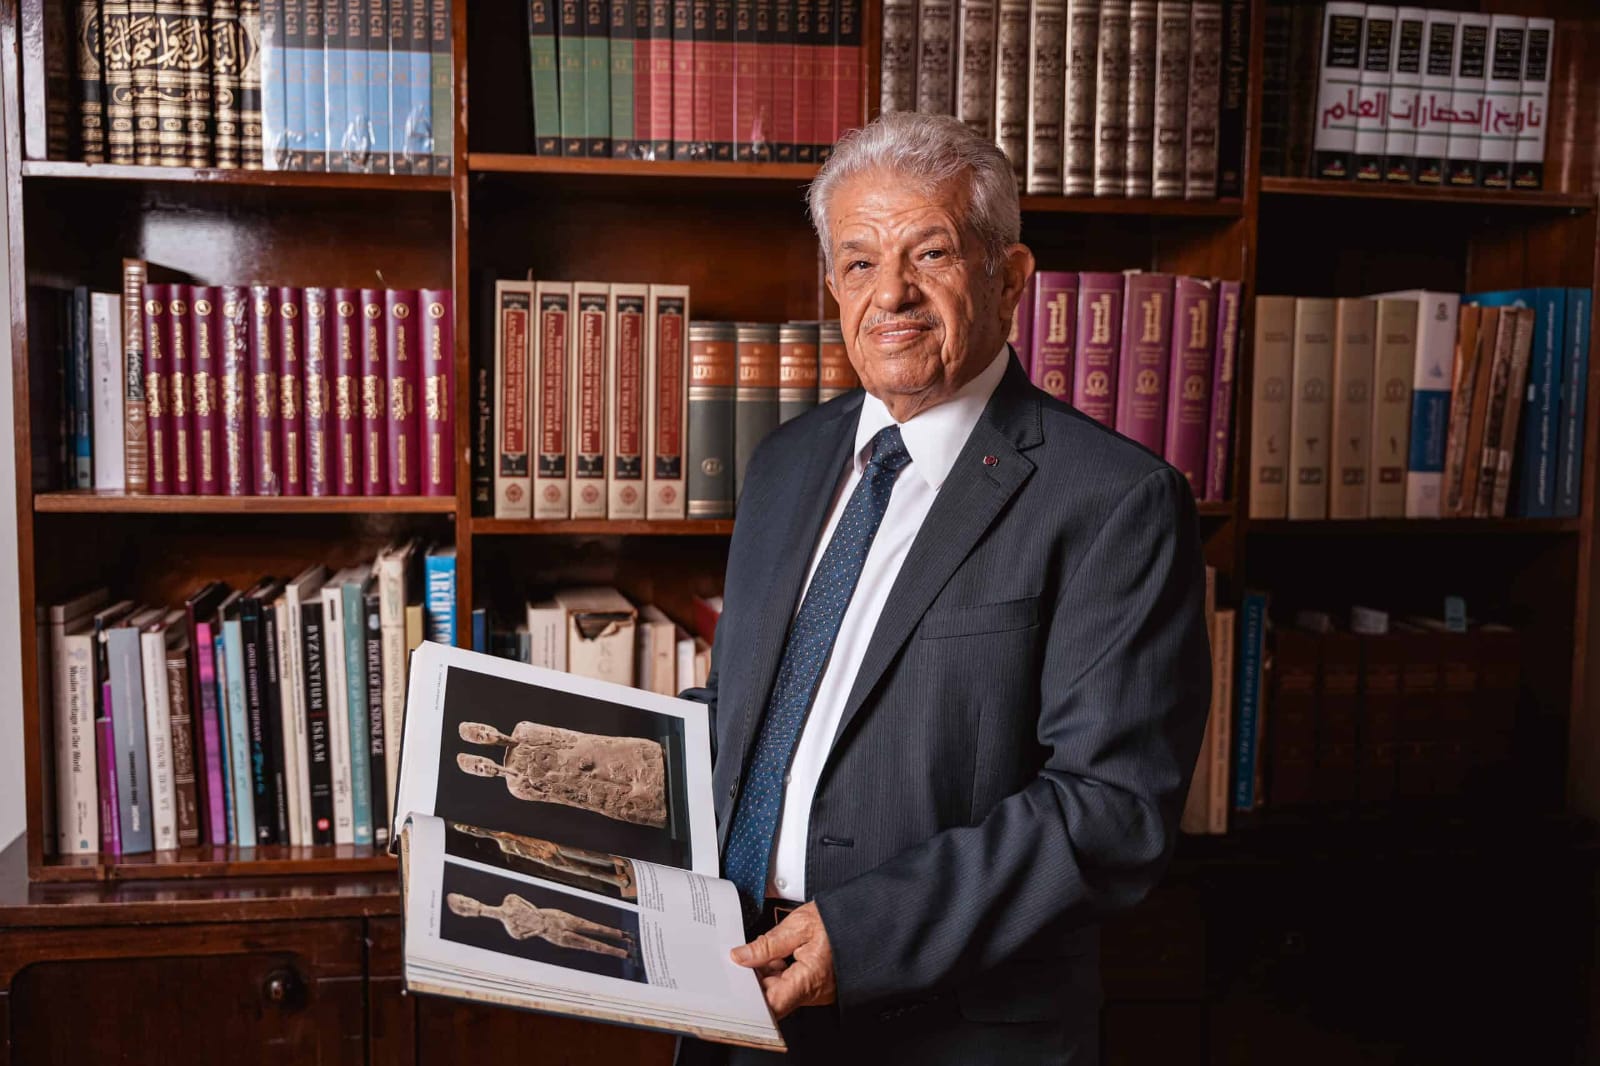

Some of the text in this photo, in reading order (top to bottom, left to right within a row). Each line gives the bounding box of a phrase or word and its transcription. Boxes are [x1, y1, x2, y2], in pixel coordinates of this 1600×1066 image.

[1322, 88, 1543, 133] تاريخ الحضارات العام
[584, 315, 593, 451] ARCHAEOLOGY IN THE NEAR EAST
[307, 625, 325, 762] BYZANTIUM ISLAM
[368, 640, 384, 756] PEOPLE OF THE STONE AGE
[73, 751, 81, 773] World
